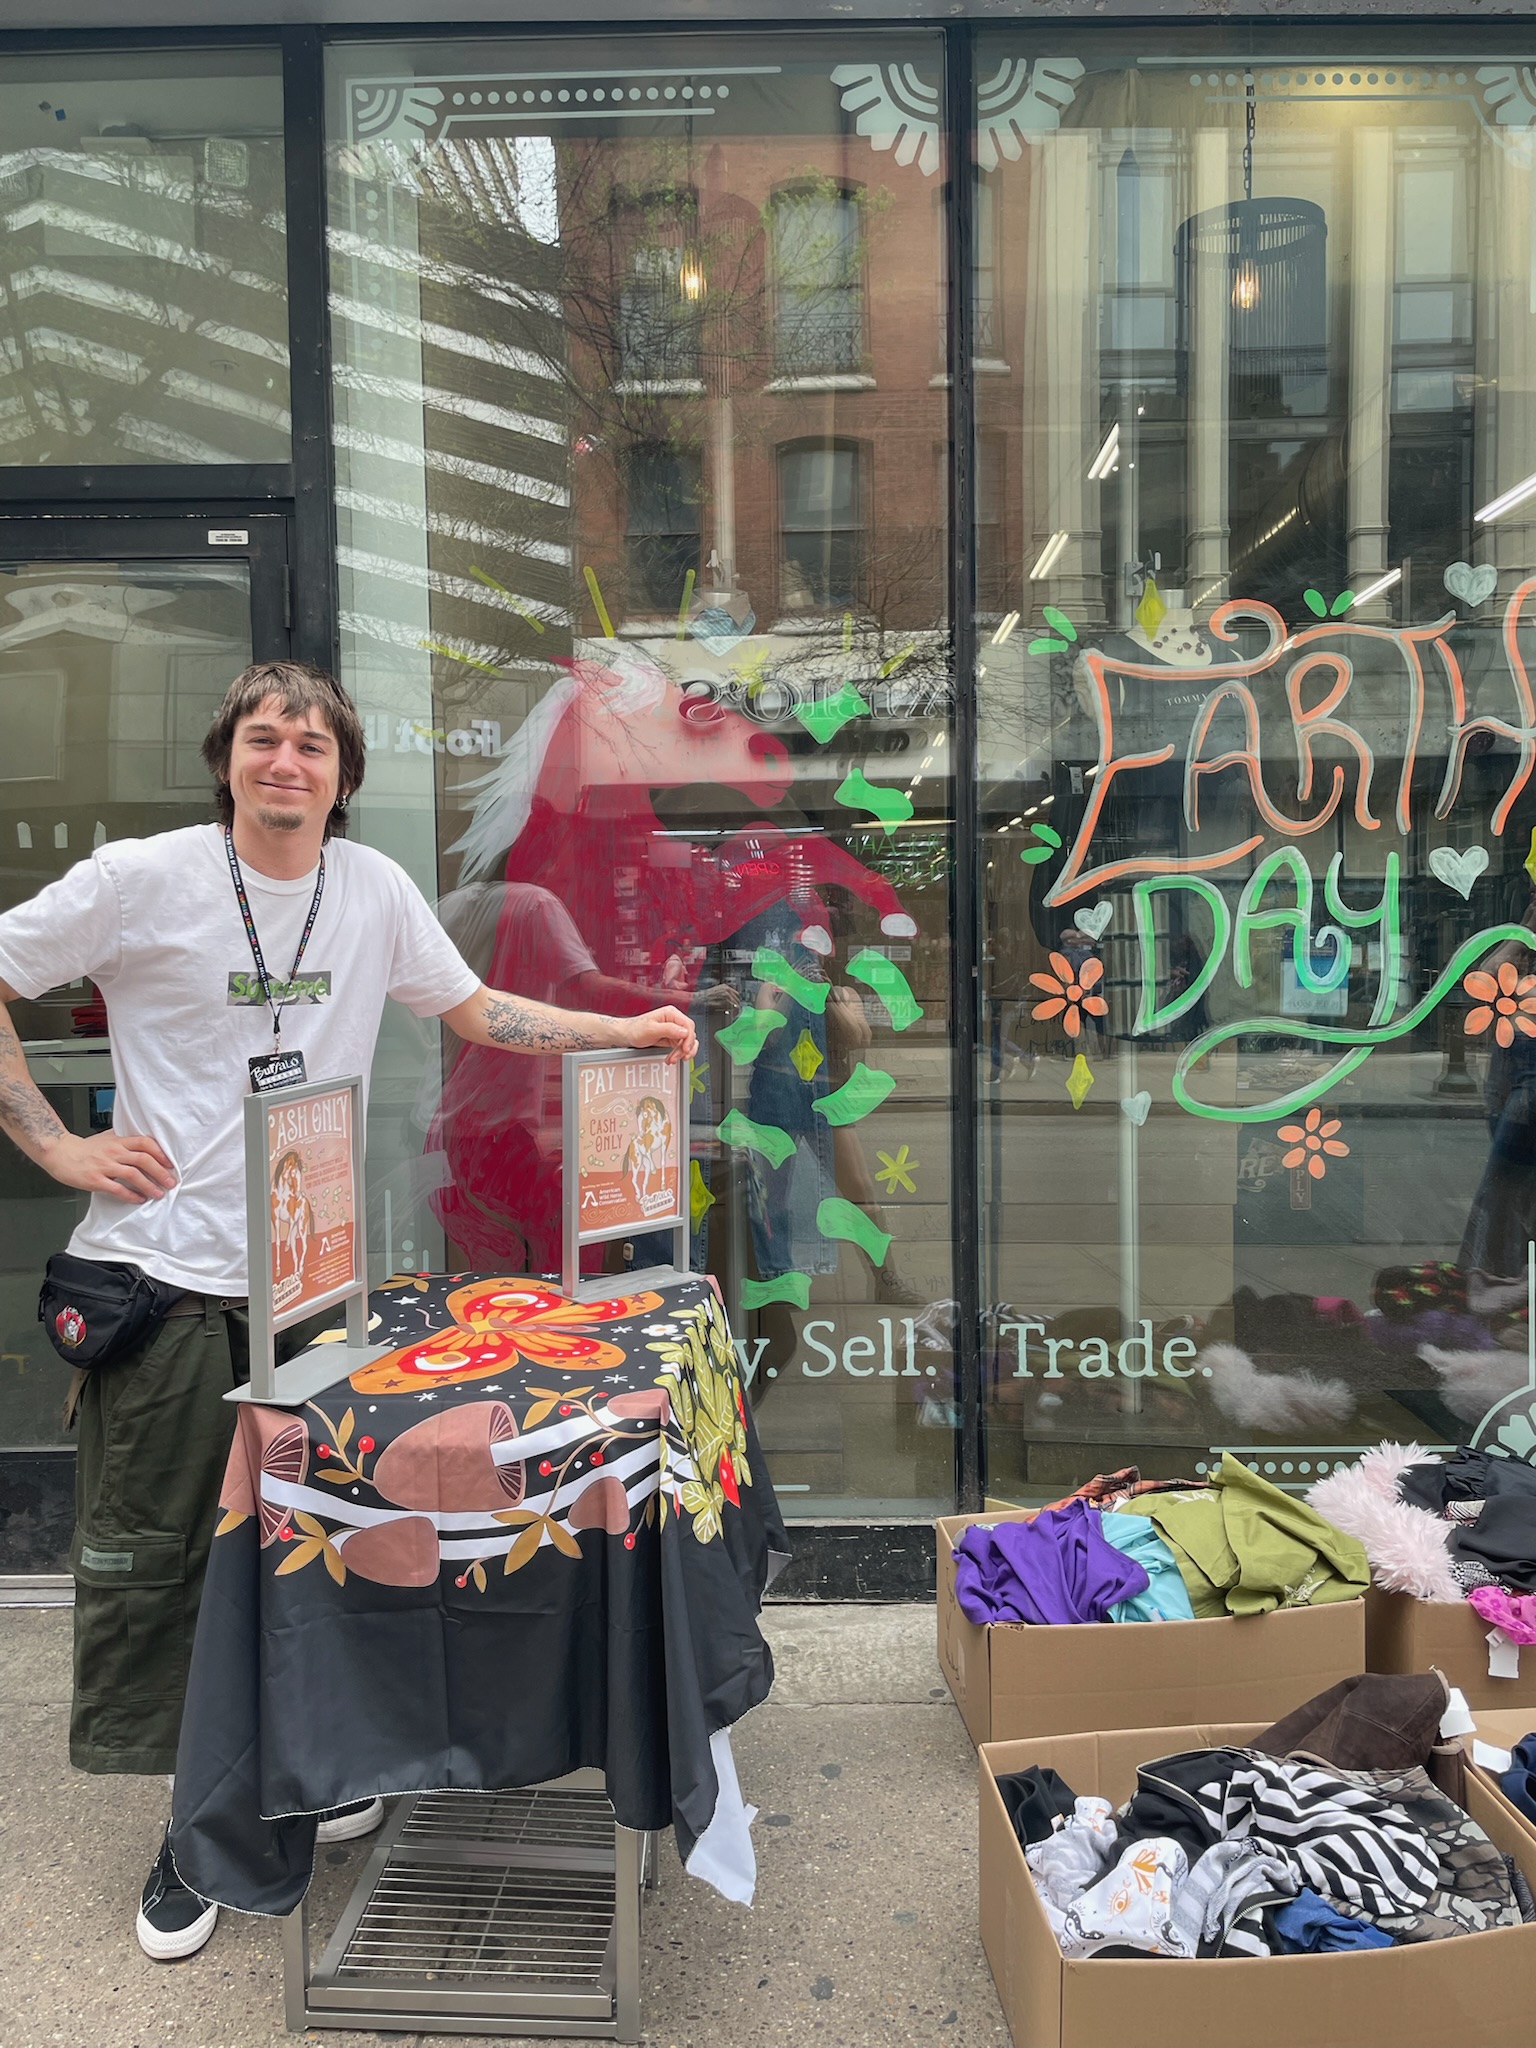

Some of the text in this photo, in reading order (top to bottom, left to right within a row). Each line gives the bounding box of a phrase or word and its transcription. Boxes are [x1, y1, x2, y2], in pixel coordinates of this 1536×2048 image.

[1043, 577, 1536, 907] EARTH
[1132, 845, 1400, 1036] DAY
[230, 974, 328, 1005] Supreme
[581, 1061, 672, 1104] PAY HERE
[312, 1095, 349, 1138] ONLY
[590, 1118, 616, 1136] CASH
[595, 1134, 623, 1152] ONLY
[732, 1317, 1213, 1391] y. Sell. Trade.
